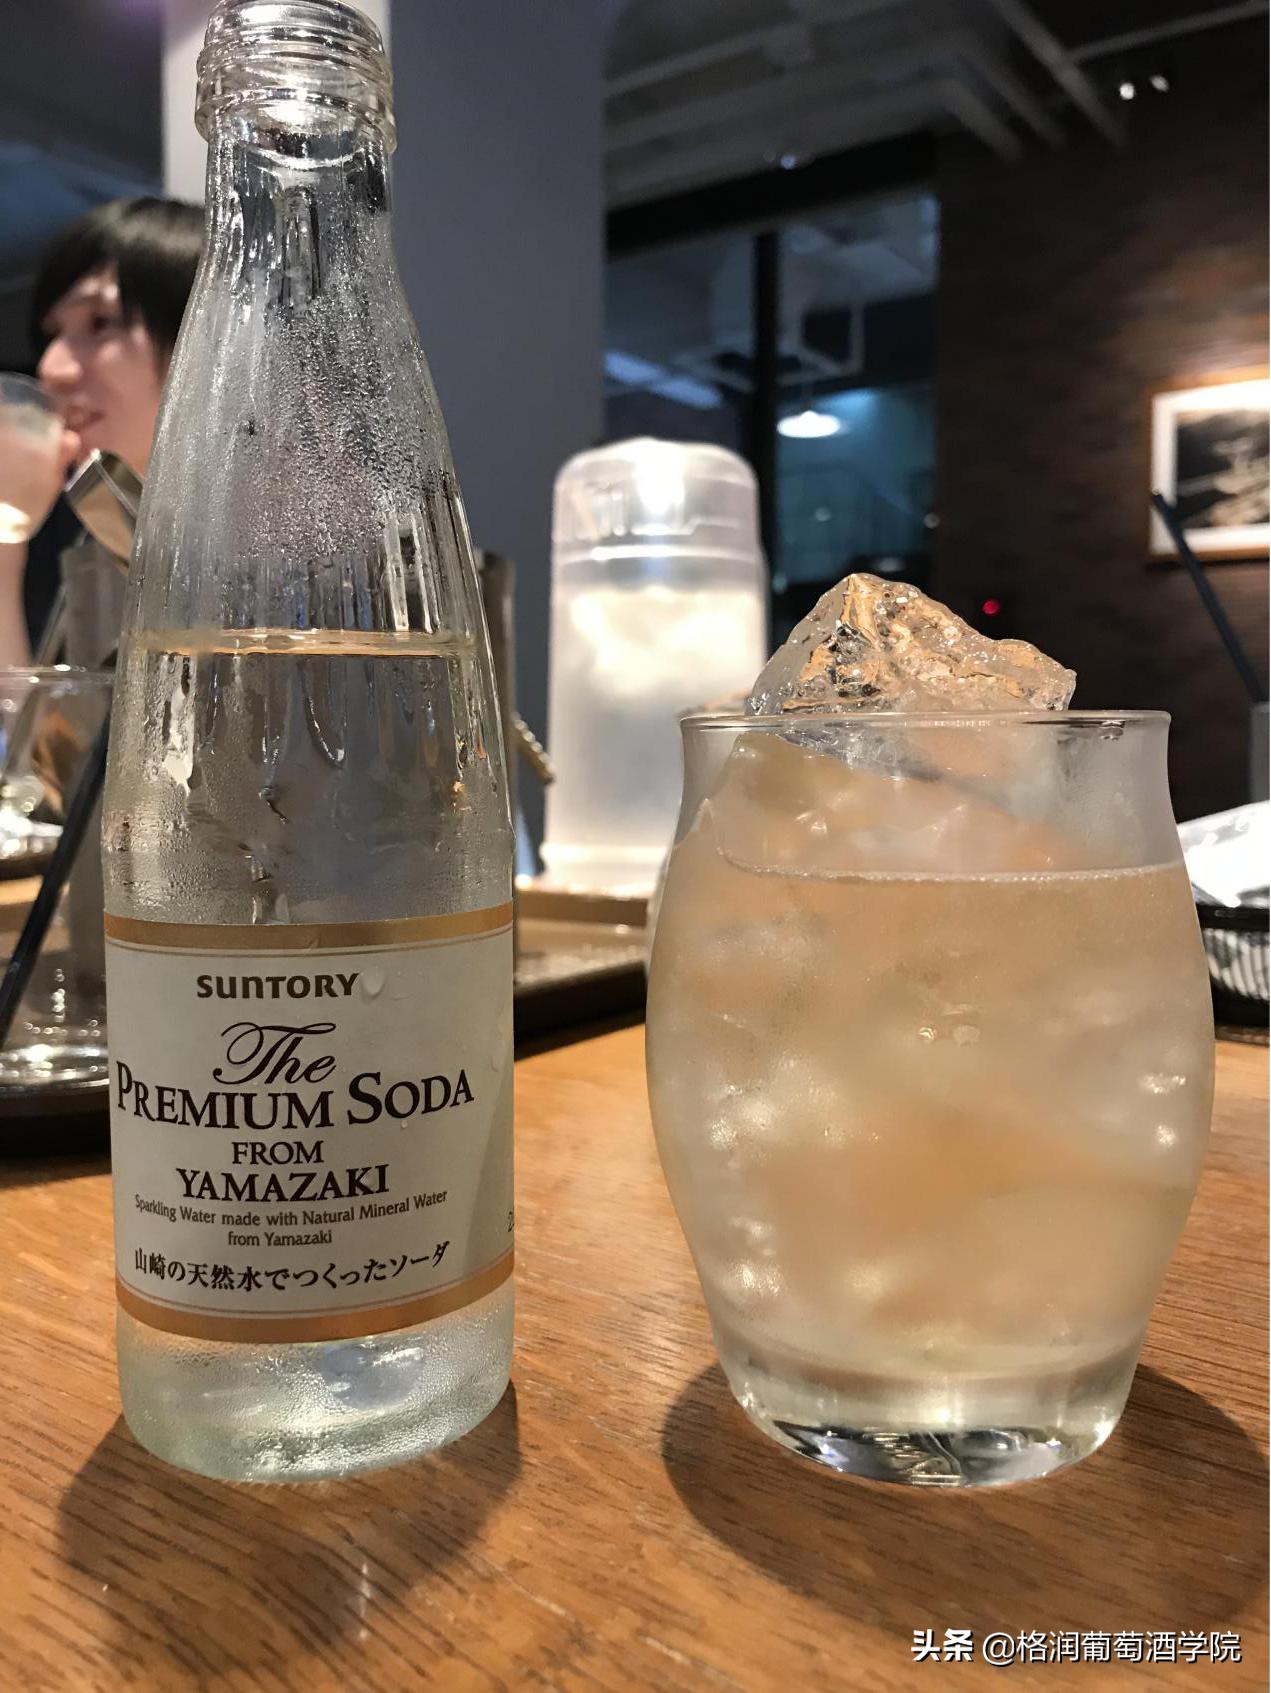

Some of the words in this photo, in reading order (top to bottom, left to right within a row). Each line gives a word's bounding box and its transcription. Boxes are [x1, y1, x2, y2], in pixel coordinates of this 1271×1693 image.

[212, 1021, 337, 1085] The
[116, 1060, 335, 1130] PREMIUM
[346, 1069, 475, 1125] SODA
[231, 1140, 324, 1165] FROM
[176, 1164, 390, 1202] YAMAZAKI
[135, 1194, 177, 1223] Sparkling
[179, 1206, 216, 1225] Water
[221, 1210, 261, 1226] made
[266, 1210, 298, 1226] with
[303, 1207, 355, 1225] Natural
[360, 1200, 410, 1220] Mineral
[413, 1189, 448, 1211] Water
[228, 1231, 260, 1247] from
[264, 1231, 333, 1247] Yamazaki
[135, 1240, 450, 1292] 山崎の天然水でつくったソーダ
